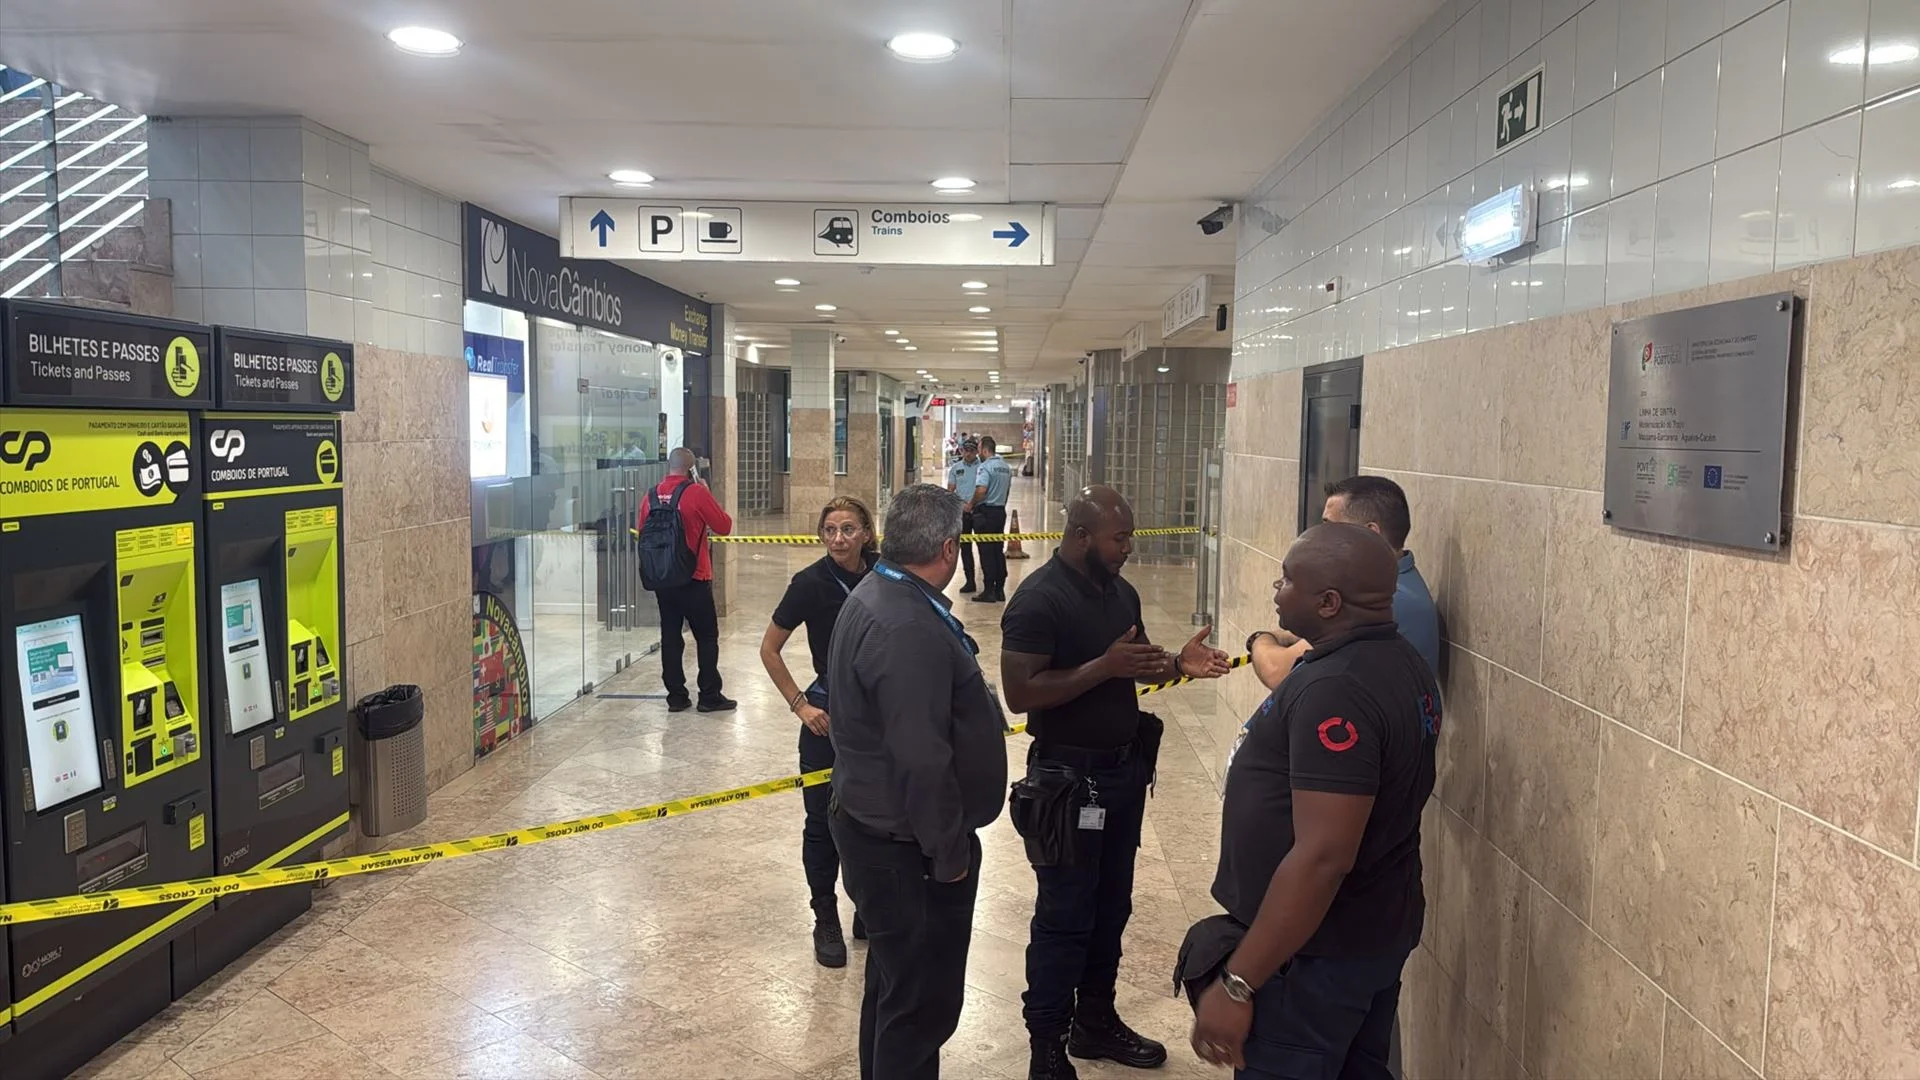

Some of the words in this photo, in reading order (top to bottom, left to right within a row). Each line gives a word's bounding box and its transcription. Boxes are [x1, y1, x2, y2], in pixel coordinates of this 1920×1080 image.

[871, 209, 950, 224] Comboios
[651, 215, 673, 245] P
[871, 226, 903, 236] Trains
[511, 247, 622, 327] NovaCâmbios
[671, 321, 688, 348] Money
[29, 334, 99, 358] BILHETES
[101, 340, 110, 359] E
[112, 341, 160, 363] PASSES
[30, 361, 72, 379] Tickets
[73, 364, 94, 380] and
[96, 366, 131, 382] Passes
[234, 352, 277, 371] BILHETES
[279, 357, 285, 372] E
[287, 358, 318, 375] PASSES
[235, 374, 260, 388] Tickets
[262, 377, 274, 389] and
[276, 377, 299, 391] Passes
[211, 468, 247, 482] COMBOIOS
[248, 468, 257, 479] DE
[257, 466, 290, 479] PORTUGAL
[0, 479, 53, 494] COMBOIOS
[56, 478, 69, 491] DE
[72, 476, 120, 490] PORTUGAL
[690, 792, 734, 809] ATRAVESSAR
[545, 826, 572, 839] CROSS
[573, 823, 589, 832] NOT
[590, 821, 604, 830] DO
[360, 853, 421, 870] ATRAVESSAR
[423, 850, 443, 861] NÃO
[159, 889, 195, 901] CROSS
[196, 885, 220, 896] NOT
[222, 883, 239, 892] DO
